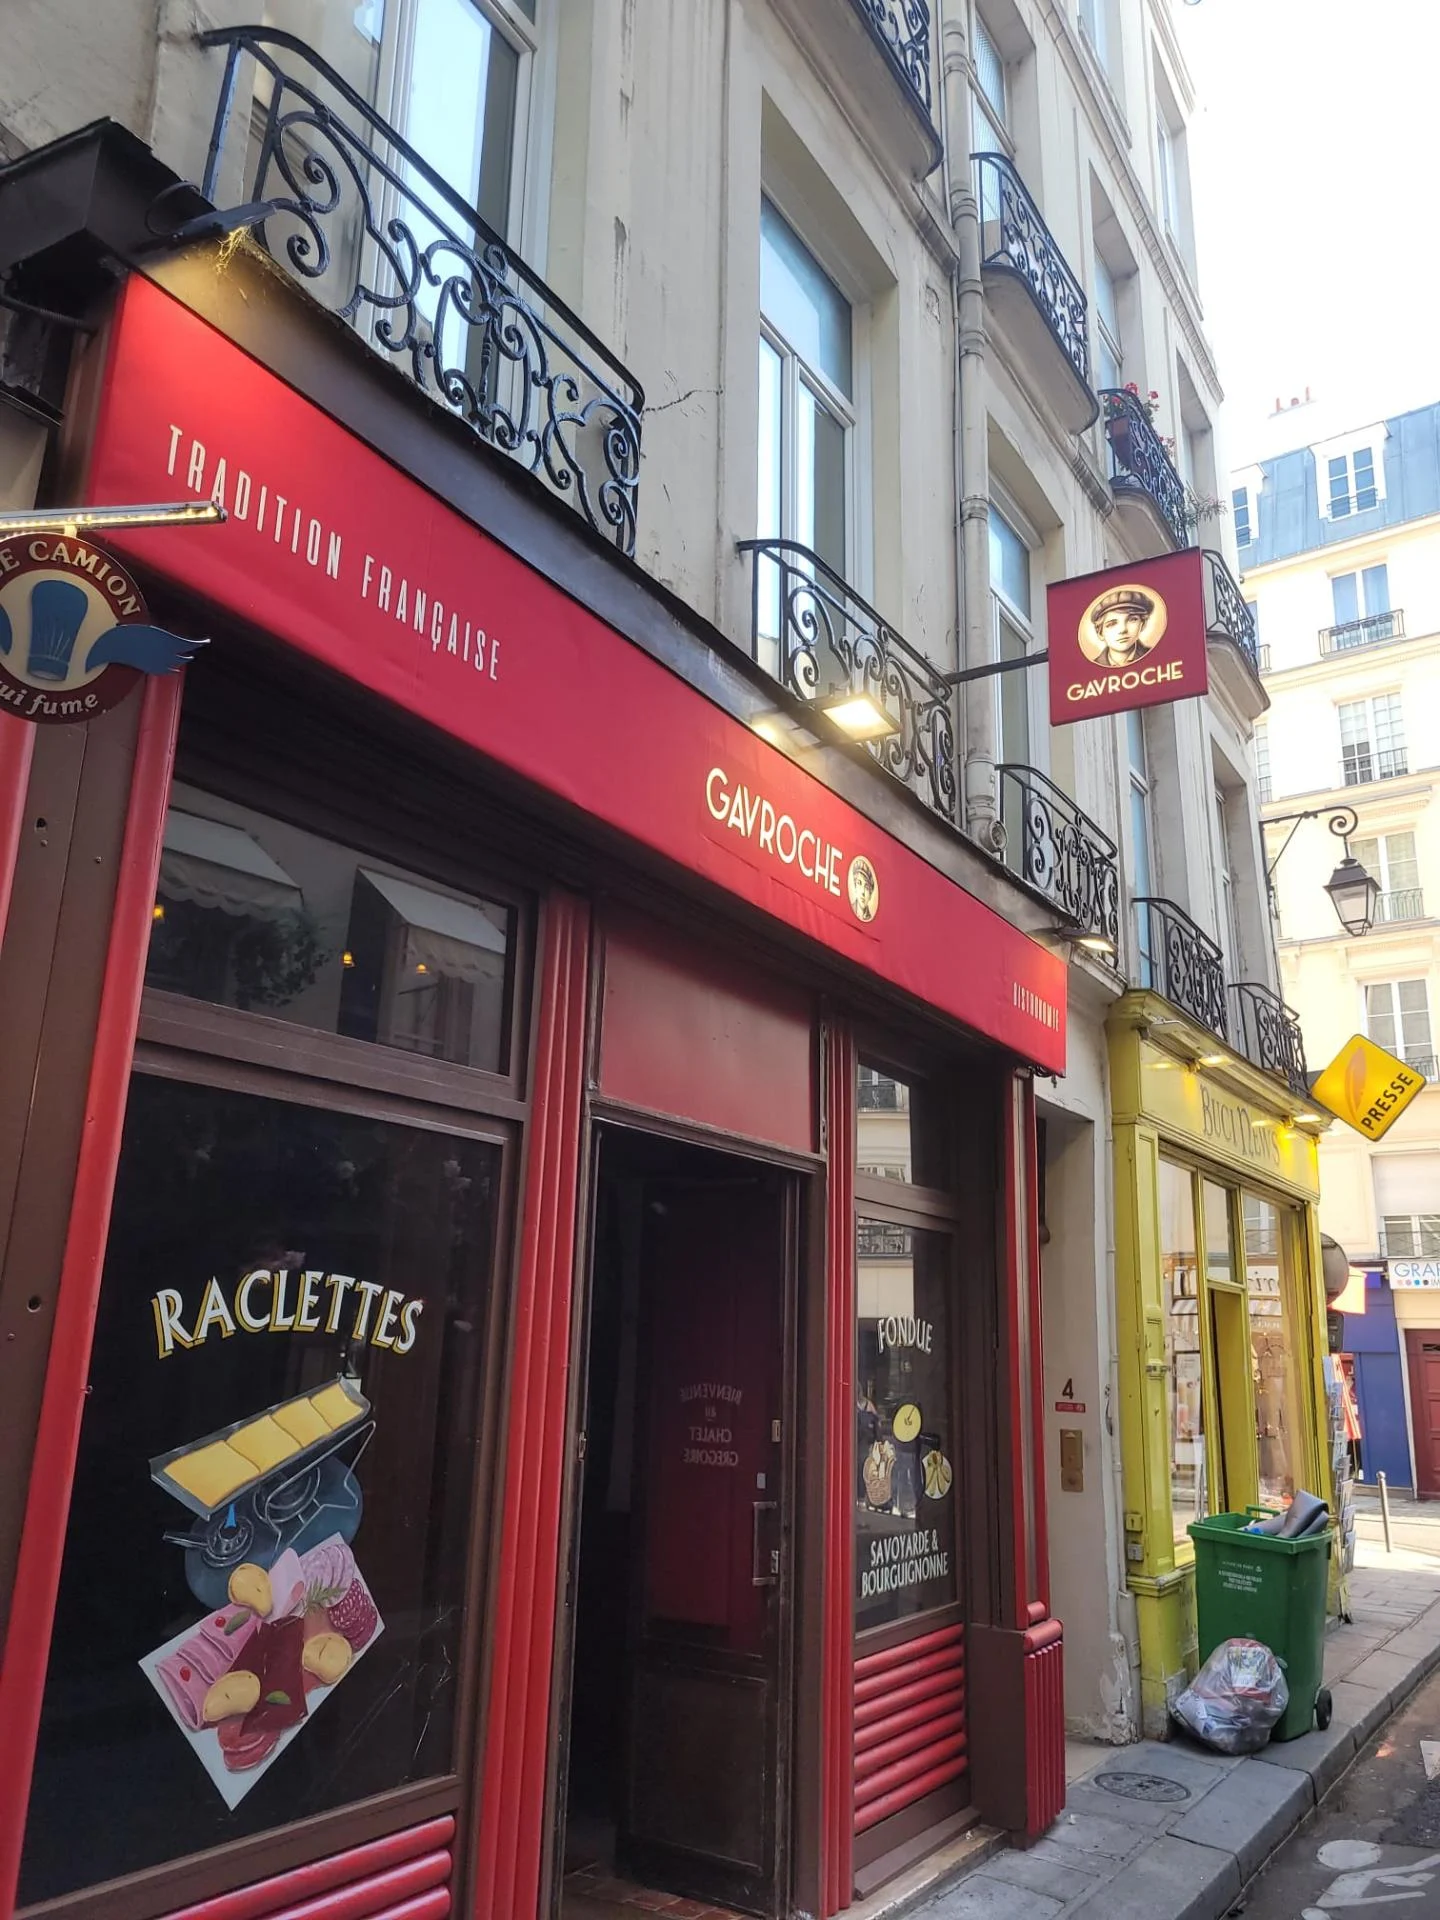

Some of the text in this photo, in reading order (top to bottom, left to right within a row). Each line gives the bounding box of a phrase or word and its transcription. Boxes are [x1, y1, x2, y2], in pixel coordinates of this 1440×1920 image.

[167, 424, 500, 681] TRADITION FRANÇAISE
[0, 541, 140, 616] E CAMION
[0, 680, 98, 715] ui fume
[1067, 660, 1184, 701] GAVROCHE
[706, 767, 843, 897] GAVROCHE
[1361, 1073, 1414, 1131] PRESSE
[150, 1269, 424, 1360] RACLETTES
[877, 1316, 933, 1354] FONDUE
[1062, 1378, 1074, 1400] 4
[871, 1528, 939, 1567] SAVOYARDE &
[861, 1552, 949, 1599] BOURGUIGNONNE
